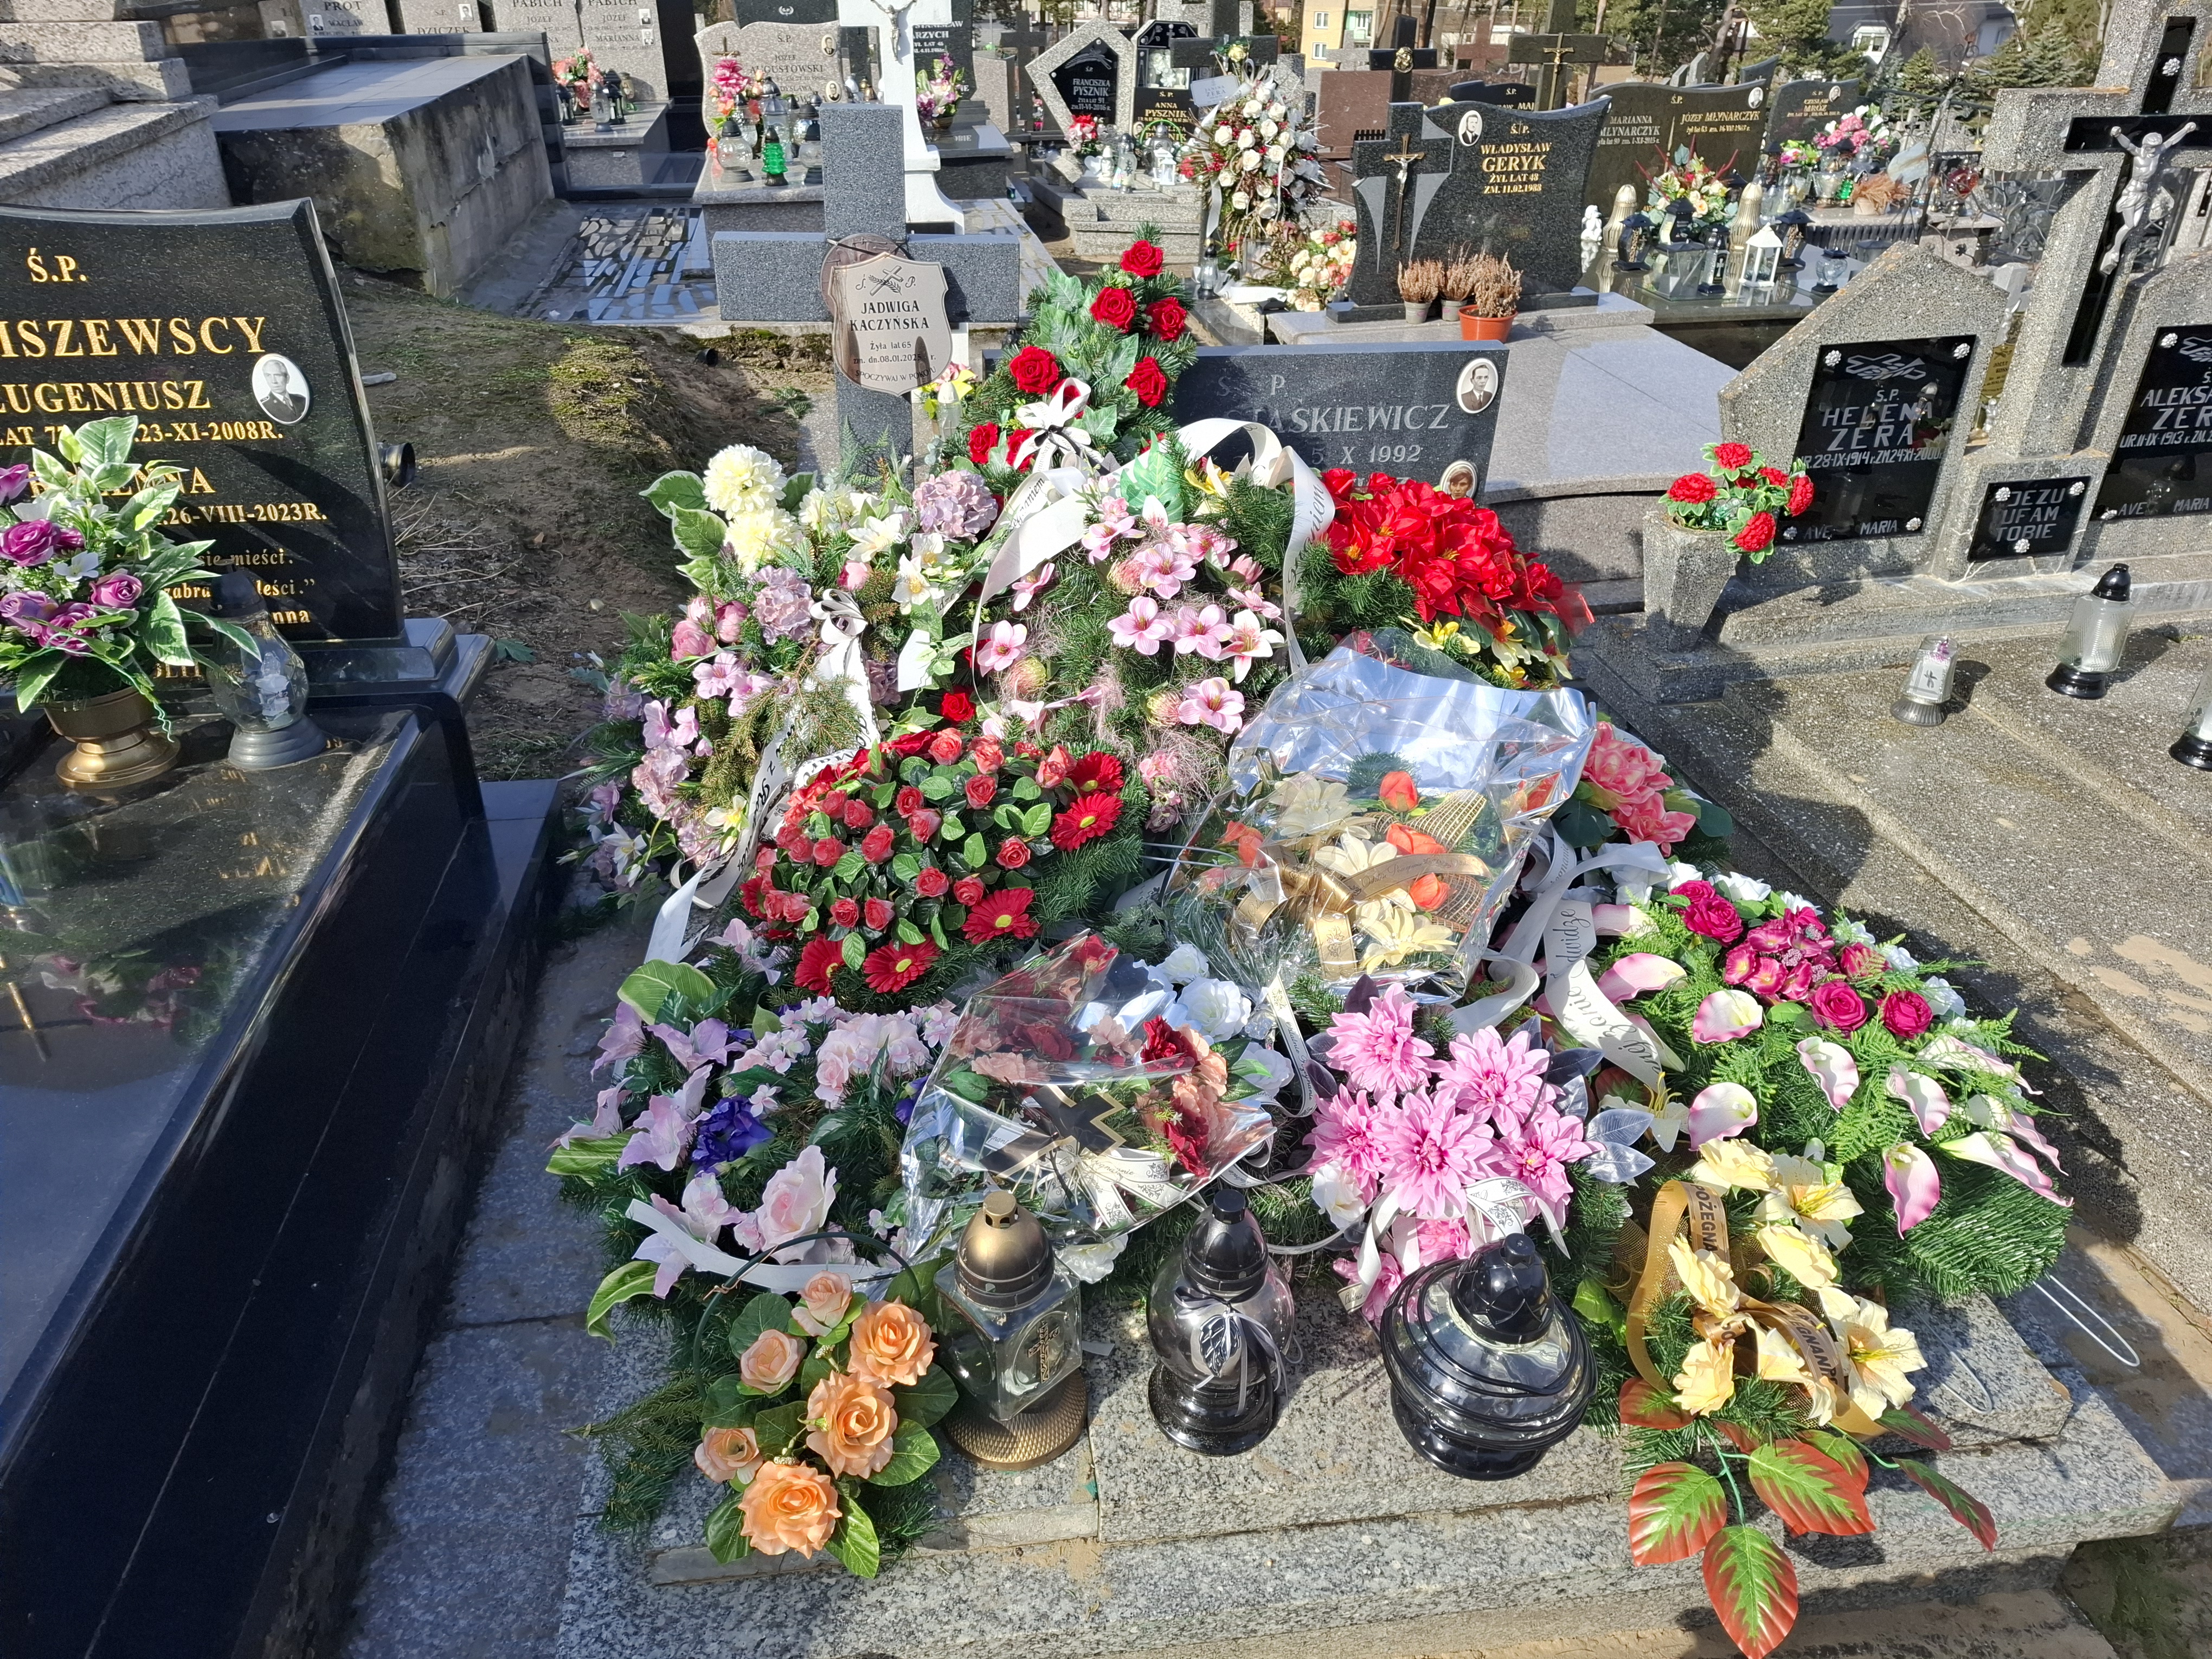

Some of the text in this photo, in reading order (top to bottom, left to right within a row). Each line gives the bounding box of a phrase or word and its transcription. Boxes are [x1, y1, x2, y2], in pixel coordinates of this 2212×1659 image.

[1073, 86, 1109, 97] PYSZNIK
[1145, 110, 1188, 118] PYSZNIK
[1610, 115, 1652, 124] MARIANNA
[1680, 112, 1703, 125] JÓZEF
[1146, 132, 1186, 141] PYNIK
[1482, 155, 1547, 172] GERYK
[1510, 173, 1528, 182] LAT
[1483, 185, 1500, 194] ZM.
[28, 248, 87, 283] Ś.P.
[861, 300, 921, 314] JADWIGA
[850, 316, 930, 332] KACZYŃSKA
[855, 370, 898, 382] SPOCZYWAJ
[0, 380, 211, 413] UGENIUSZ
[1822, 402, 1933, 427] HELENA
[0, 426, 35, 445] AT
[1827, 423, 1913, 451] ZERA
[1369, 445, 1422, 464] 1992
[2007, 488, 2066, 507] JEZU
[2001, 506, 2060, 524] UFAM
[2118, 498, 2210, 516] AVE MARIA
[1804, 520, 1898, 539] AVE MARIA
[1996, 523, 2057, 542] TOBIE
[1549, 908, 1591, 979] Jdwidze
[1690, 1184, 1719, 1252] POŻEGNA
